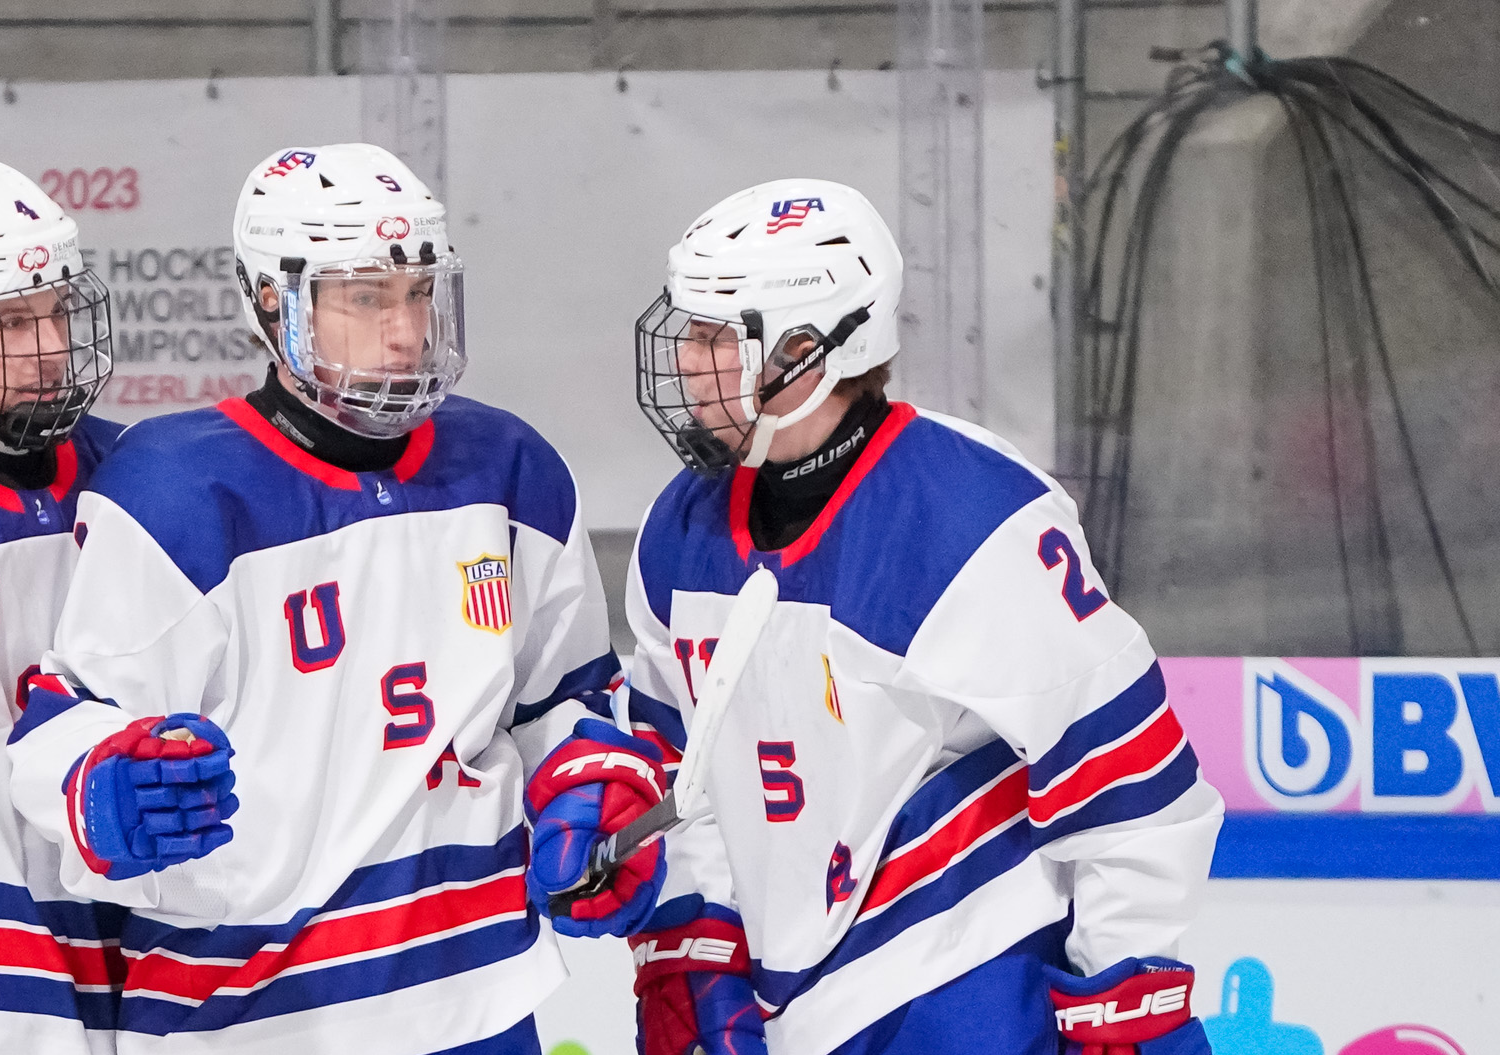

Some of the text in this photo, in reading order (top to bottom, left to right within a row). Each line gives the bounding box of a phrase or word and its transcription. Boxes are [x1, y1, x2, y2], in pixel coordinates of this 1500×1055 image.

[41, 166, 140, 210] 2023
[376, 175, 402, 193] 9
[14, 200, 40, 221] 4
[767, 198, 826, 227] USA
[108, 247, 236, 283] HOCKE
[761, 276, 822, 290] BAUER
[113, 288, 243, 322] WORLD
[784, 345, 825, 384] BAUER
[781, 425, 865, 481] BAUER
[470, 562, 506, 581] USA
[1037, 526, 1109, 623] 2
[633, 937, 738, 974] RUE
